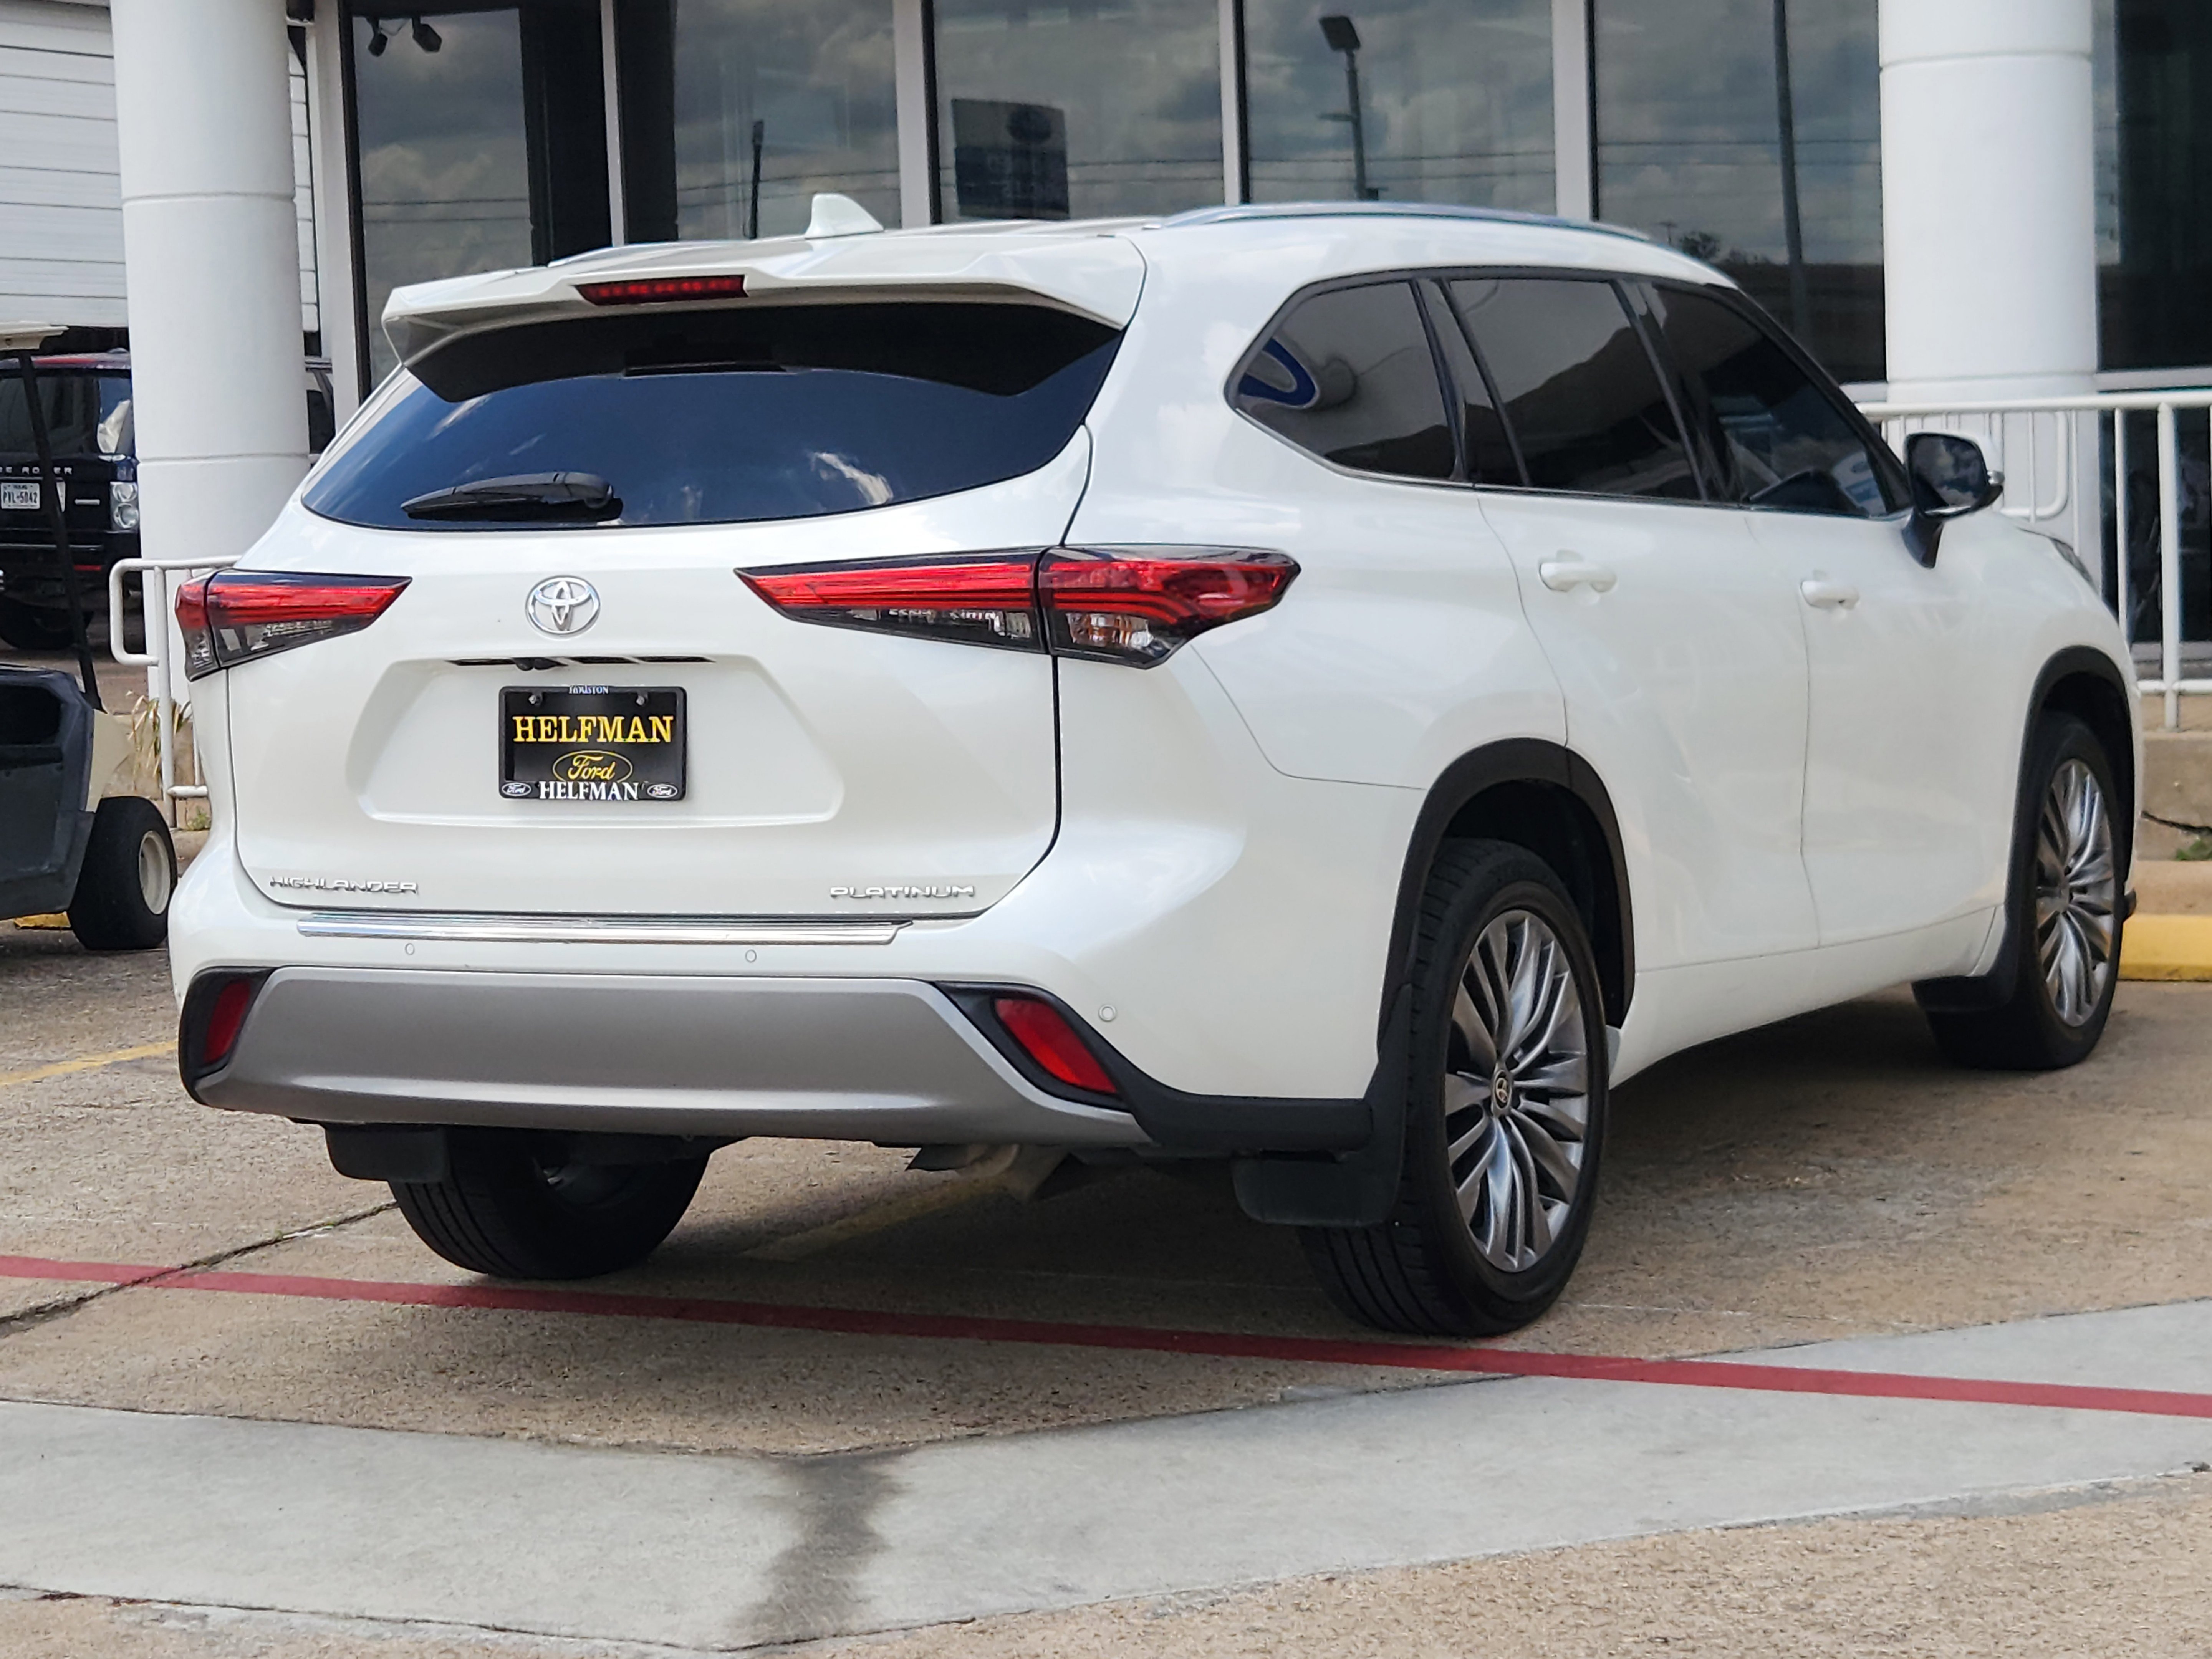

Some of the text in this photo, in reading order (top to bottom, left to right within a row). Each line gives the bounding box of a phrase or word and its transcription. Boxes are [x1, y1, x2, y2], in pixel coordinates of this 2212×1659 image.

[513, 716, 674, 742] HELFMAN
[568, 754, 615, 780] Ford
[539, 781, 639, 800] HELFMAN
[270, 875, 418, 894] HIGHLANDER
[830, 886, 974, 898] PLATINUM
